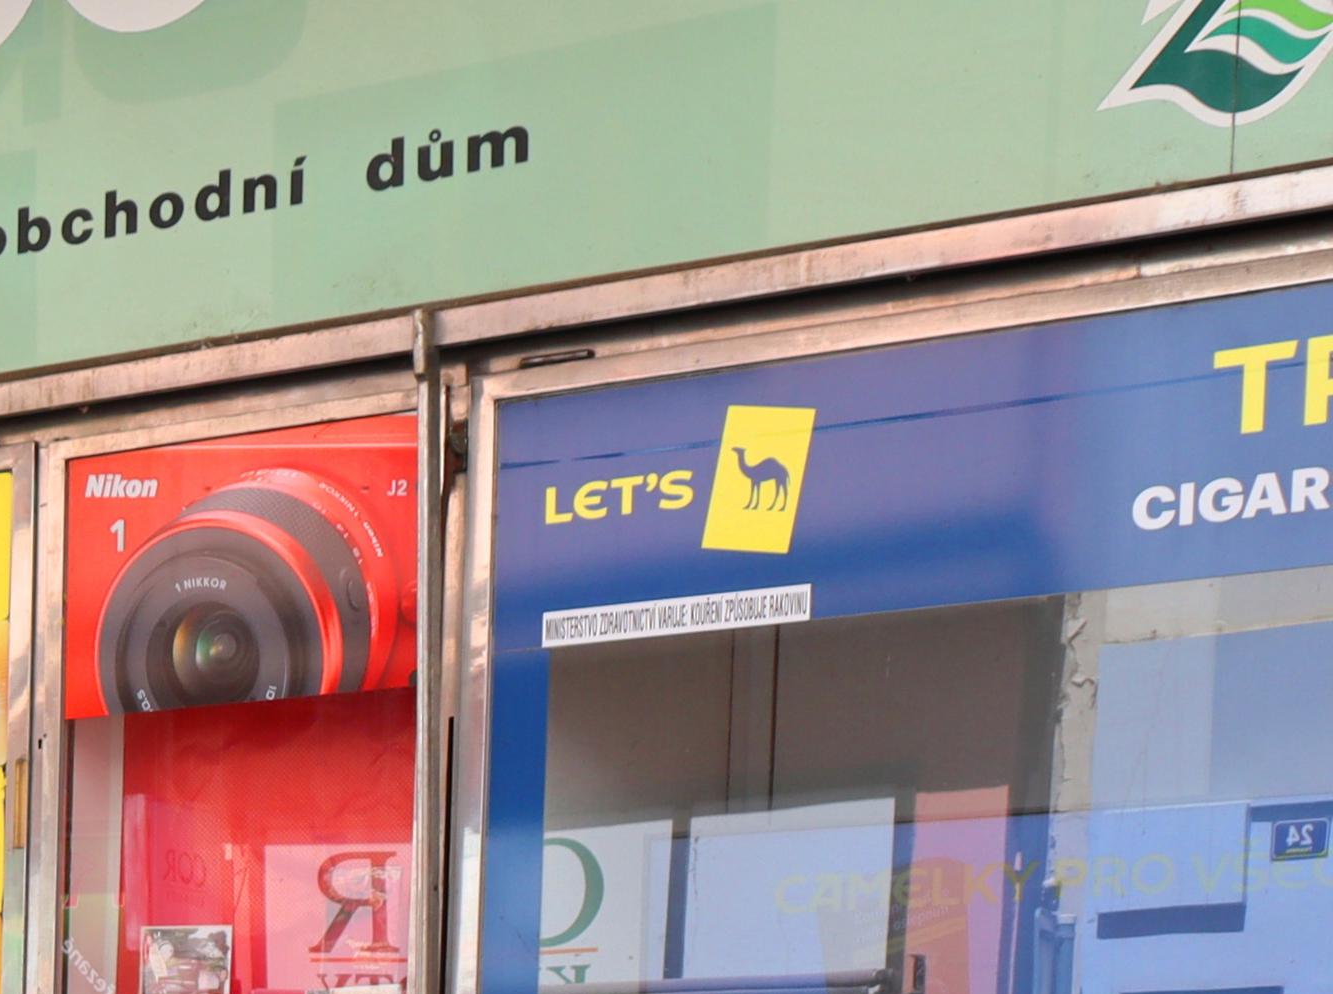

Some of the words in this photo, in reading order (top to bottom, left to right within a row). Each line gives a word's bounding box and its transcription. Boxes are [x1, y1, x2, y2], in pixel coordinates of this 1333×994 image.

[365, 125, 530, 192] dům
[84, 473, 159, 499] Nikon
[386, 478, 408, 497] J2
[544, 469, 694, 526] LET'S
[109, 519, 127, 553] 1
[183, 576, 228, 592] NIKKOR
[544, 613, 599, 642] MINISTERSTVO
[599, 602, 656, 636] ZDRAVOTNICTVÍ
